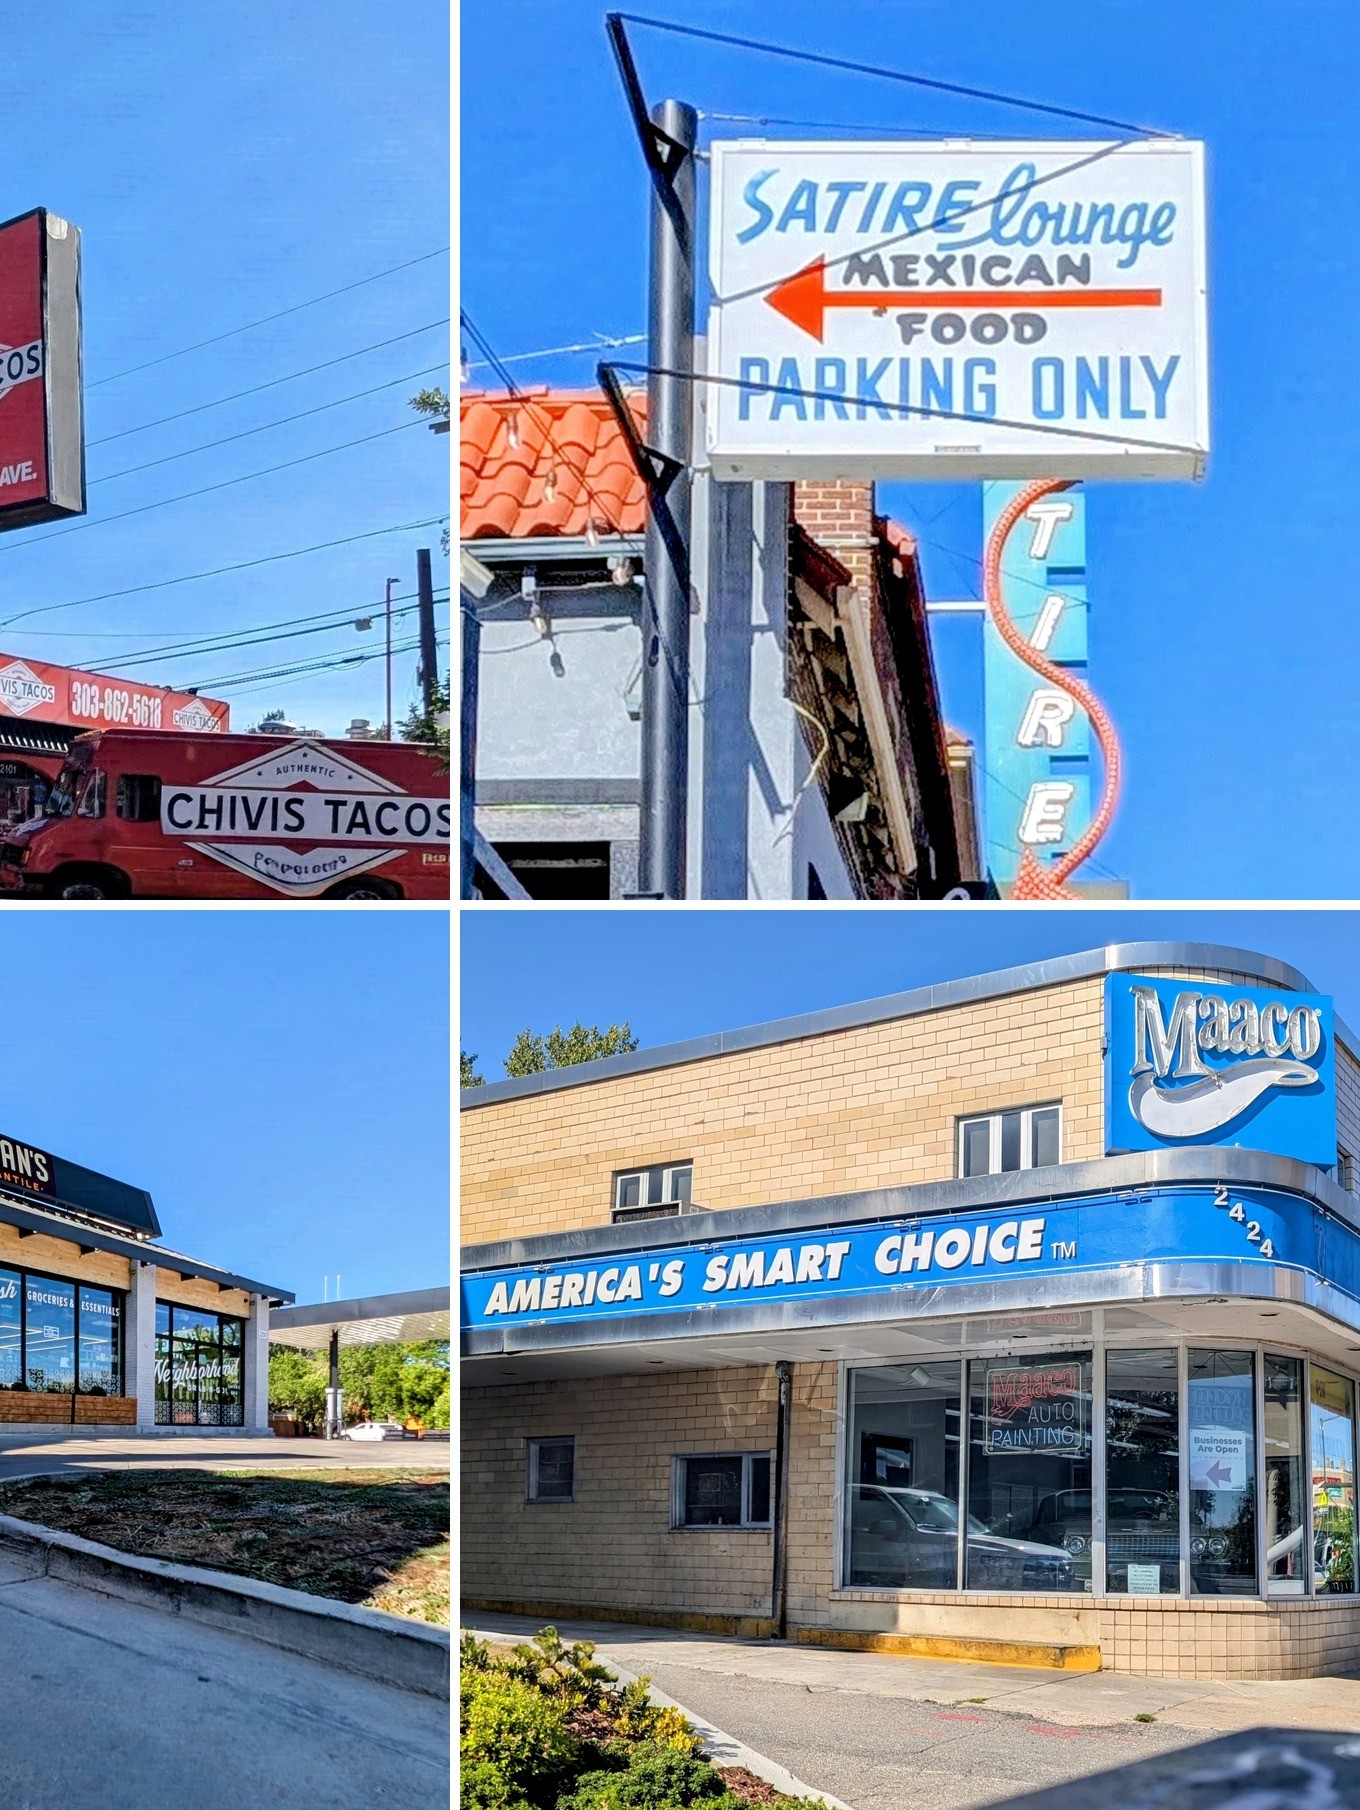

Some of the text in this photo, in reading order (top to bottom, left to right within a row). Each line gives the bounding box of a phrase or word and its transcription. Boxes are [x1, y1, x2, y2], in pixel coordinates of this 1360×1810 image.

[736, 160, 1177, 269] SATIRE lounge
[842, 252, 1092, 288] MEXICAN
[896, 312, 1049, 346] FOOD
[739, 354, 1182, 422] PARKING ONLY
[21, 682, 54, 702] TACOS
[71, 681, 162, 729] 303-862-5618
[173, 711, 197, 727] CHIVIS
[0, 763, 17, 775] 2101
[275, 764, 336, 778] AUTHENTIC
[166, 792, 450, 838] CHIVIS TACOS
[1129, 985, 1320, 1078] Maaco
[1213, 1187, 1274, 1258] 2424
[484, 1260, 685, 1316] AMERICA'S
[702, 1241, 850, 1292] SMART
[874, 1218, 1045, 1275] CHOICE
[27, 1290, 120, 1317] GROCERIES & ESSENTIALS
[991, 1368, 1077, 1416] Maaco
[1028, 1402, 1075, 1423] AUTO
[991, 1426, 1074, 1446] PAINTING
[1193, 1436, 1242, 1445] Businesses
[1215, 1445, 1239, 1454] Open
